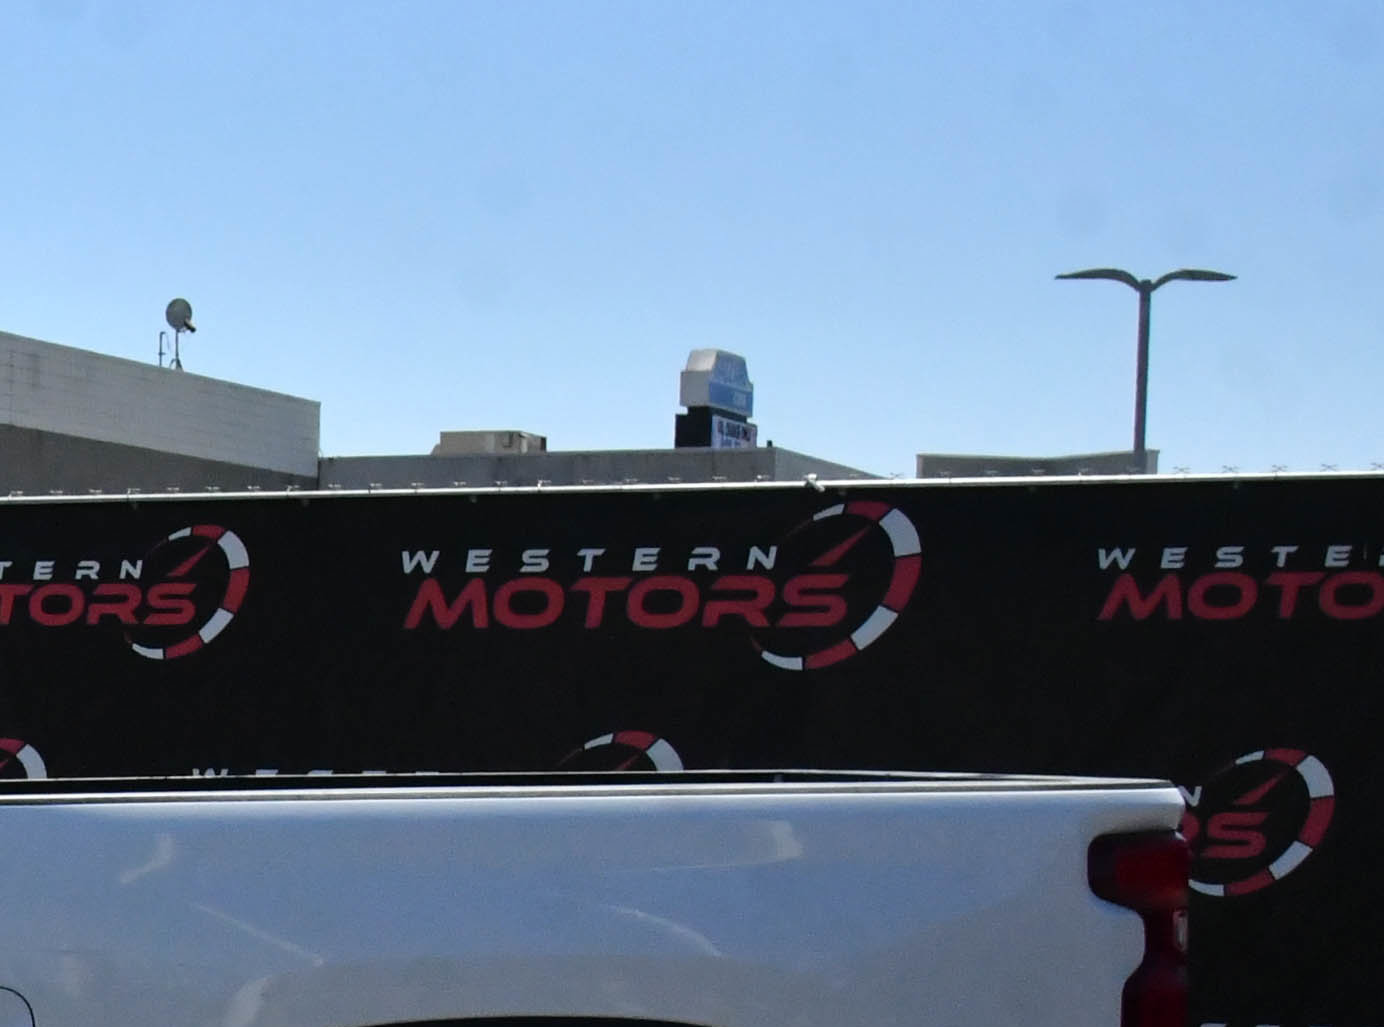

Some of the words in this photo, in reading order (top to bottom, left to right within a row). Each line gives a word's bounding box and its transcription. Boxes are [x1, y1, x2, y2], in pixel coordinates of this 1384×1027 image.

[401, 546, 777, 574] WESTERN
[1098, 545, 1384, 570] WESTE
[403, 573, 850, 630] MOTORS
